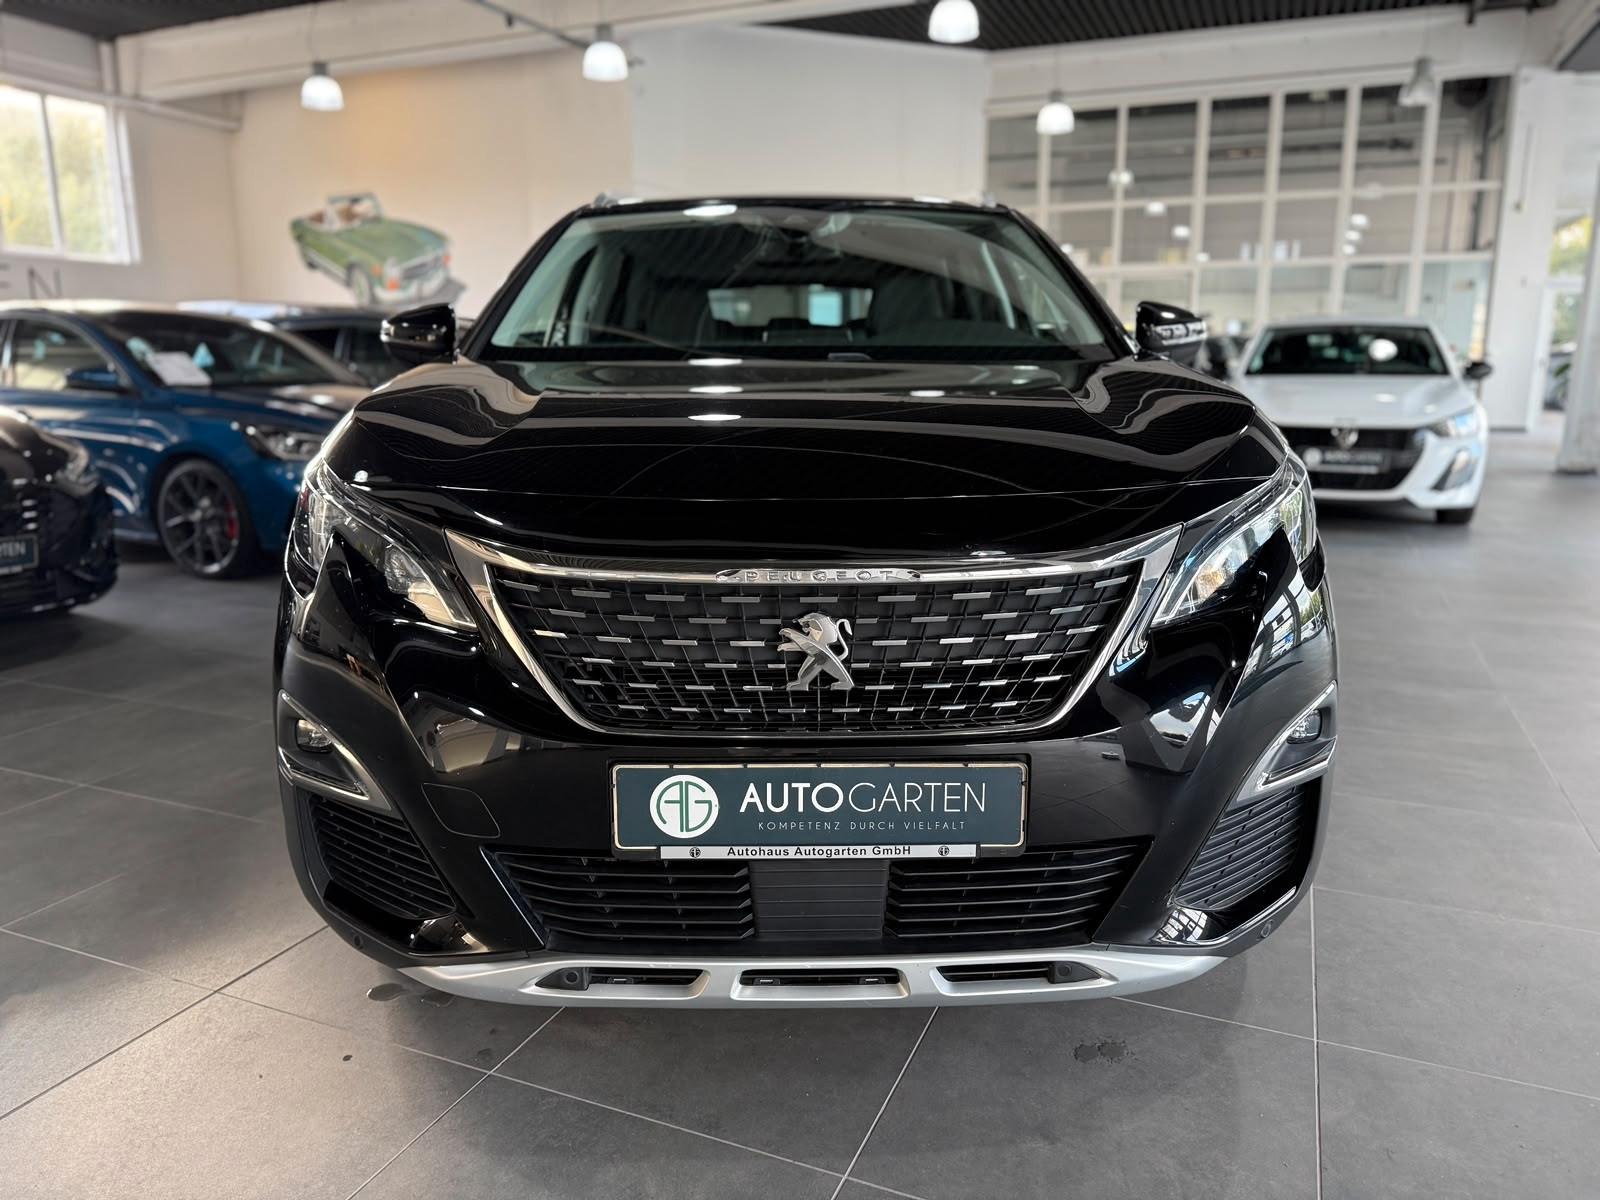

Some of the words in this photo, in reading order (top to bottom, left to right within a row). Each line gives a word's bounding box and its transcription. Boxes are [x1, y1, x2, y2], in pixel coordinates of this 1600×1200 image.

[743, 569, 893, 583] PEUGEOT
[739, 782, 986, 813] AUTOGARTEN
[758, 821, 840, 831] KOMPETENZ
[850, 821, 895, 830] DURCH
[904, 821, 966, 830] VIELFALT
[727, 847, 790, 857] Autohaus
[794, 846, 867, 858] Autogarten
[872, 845, 911, 856] GmbH
